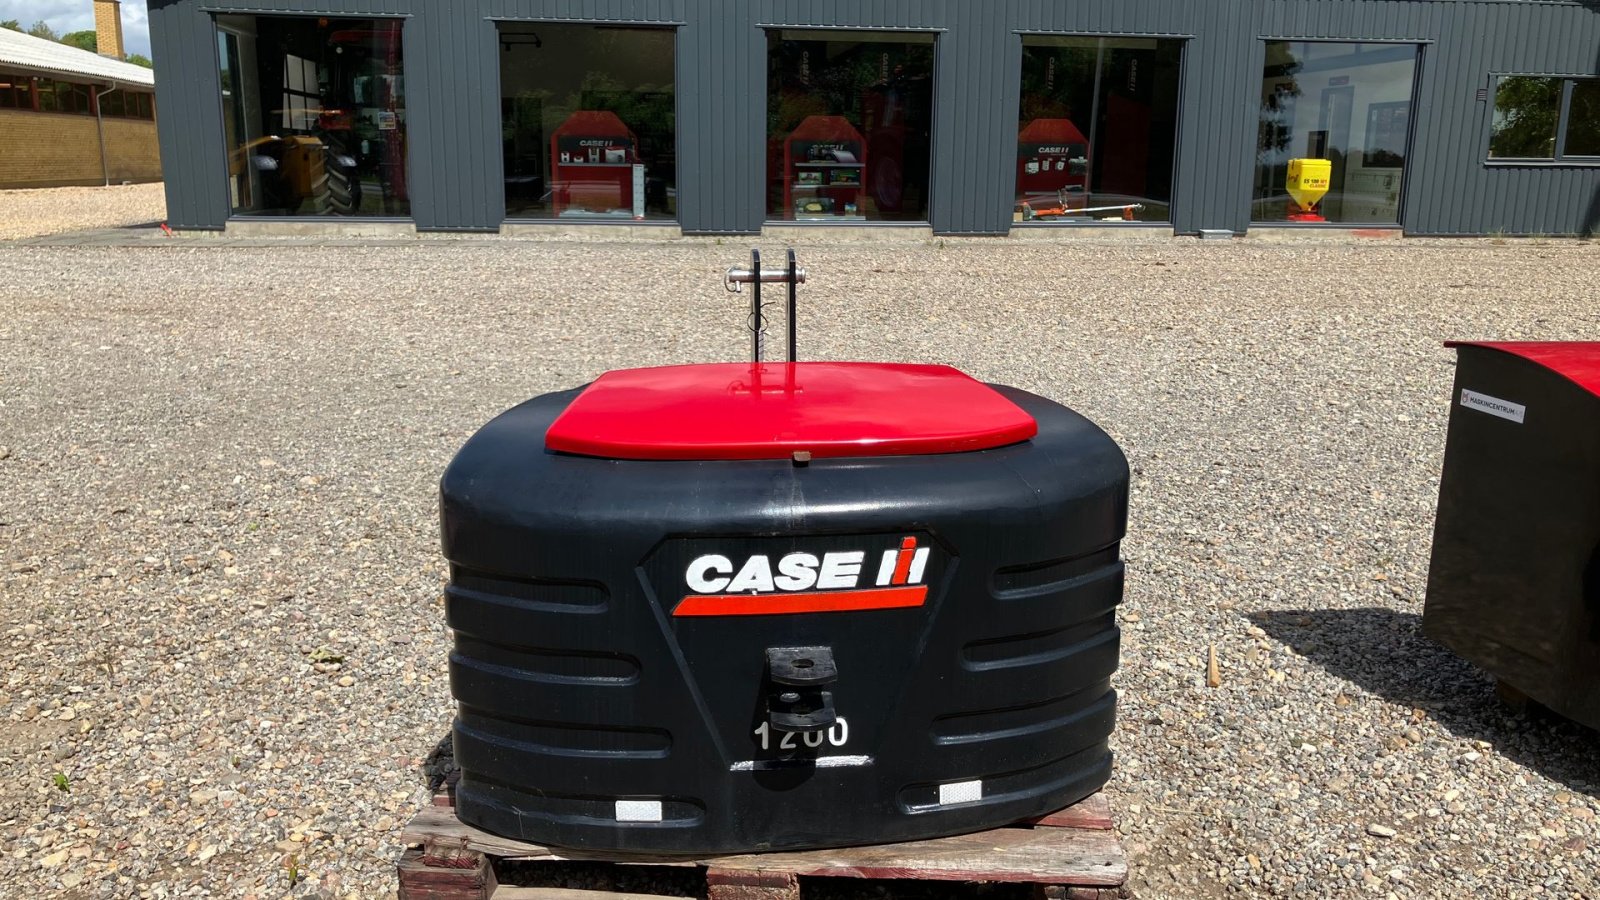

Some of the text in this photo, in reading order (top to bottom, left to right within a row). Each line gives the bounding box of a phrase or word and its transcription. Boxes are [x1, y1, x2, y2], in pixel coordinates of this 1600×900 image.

[579, 139, 604, 147] CASE
[1038, 146, 1061, 154] CASE
[685, 551, 865, 594] CASE
[753, 717, 849, 750] 1200
